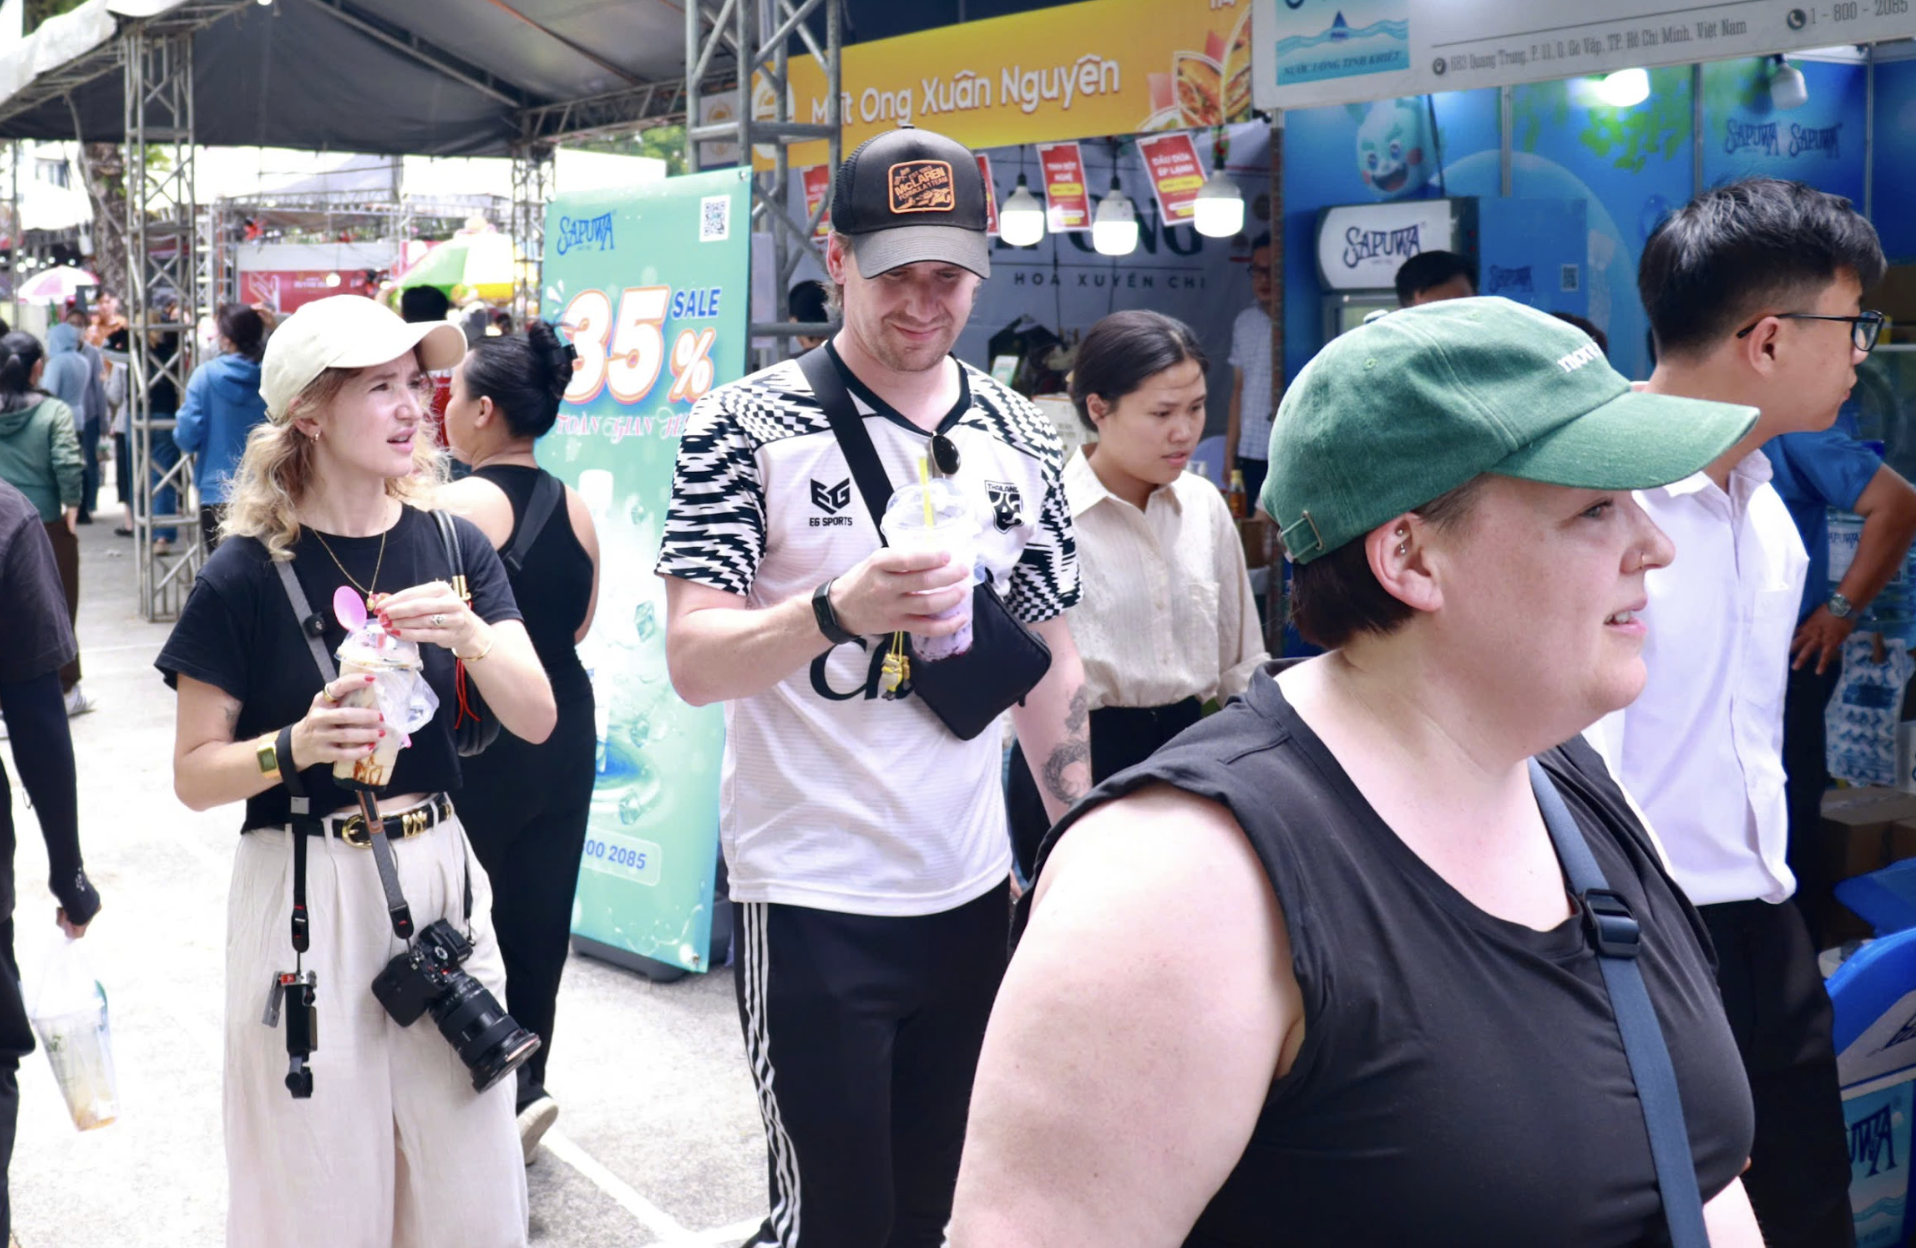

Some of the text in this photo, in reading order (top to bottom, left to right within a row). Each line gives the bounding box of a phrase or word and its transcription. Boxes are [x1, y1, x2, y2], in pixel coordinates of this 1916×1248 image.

[1833, 2, 1858, 22] 800
[1470, 52, 1497, 71] Quang
[1697, 19, 1718, 40] Việt
[1722, 17, 1748, 37] Nam
[811, 53, 1120, 127] Mt Ong Xuân Nguyên
[557, 212, 615, 256] SAPUWA
[1343, 224, 1421, 269] SAPUWA
[1014, 272, 1061, 287] HOA
[1167, 275, 1206, 289] CHI
[672, 288, 721, 319] SALE
[822, 516, 853, 527] SPORTS
[607, 844, 647, 870] 2085
